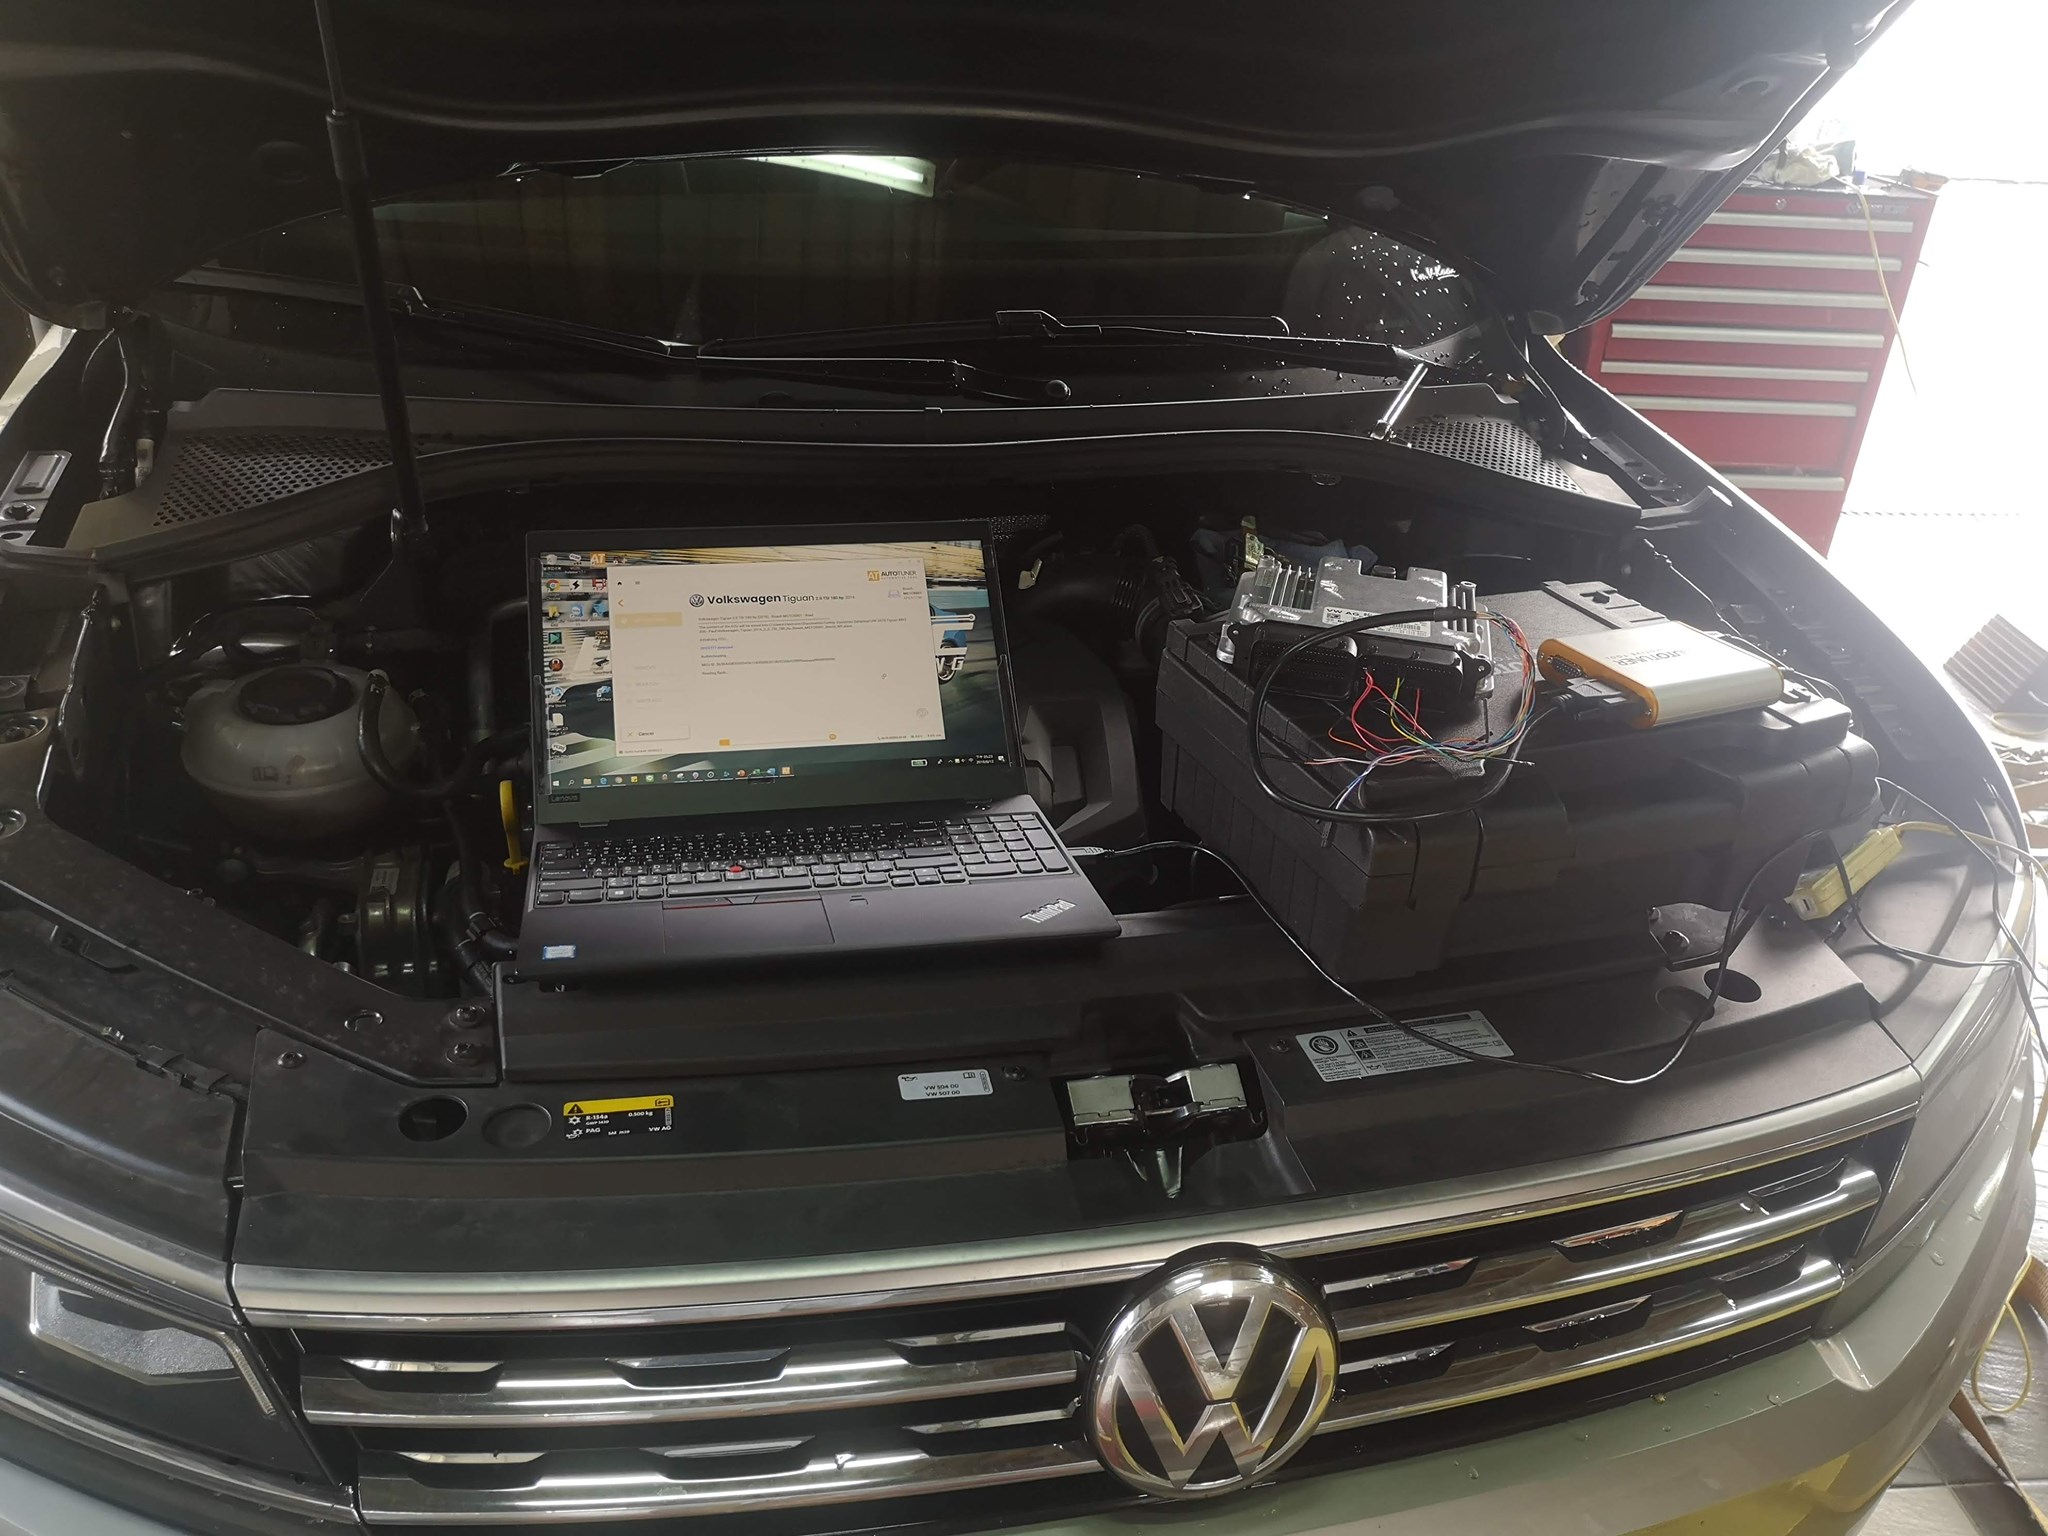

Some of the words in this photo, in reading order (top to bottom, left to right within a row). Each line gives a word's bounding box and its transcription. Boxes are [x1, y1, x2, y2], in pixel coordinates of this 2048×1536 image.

[707, 593, 781, 604] Volkswagen
[782, 594, 815, 604] Tiguan
[1020, 898, 1076, 924] ThinkPad
